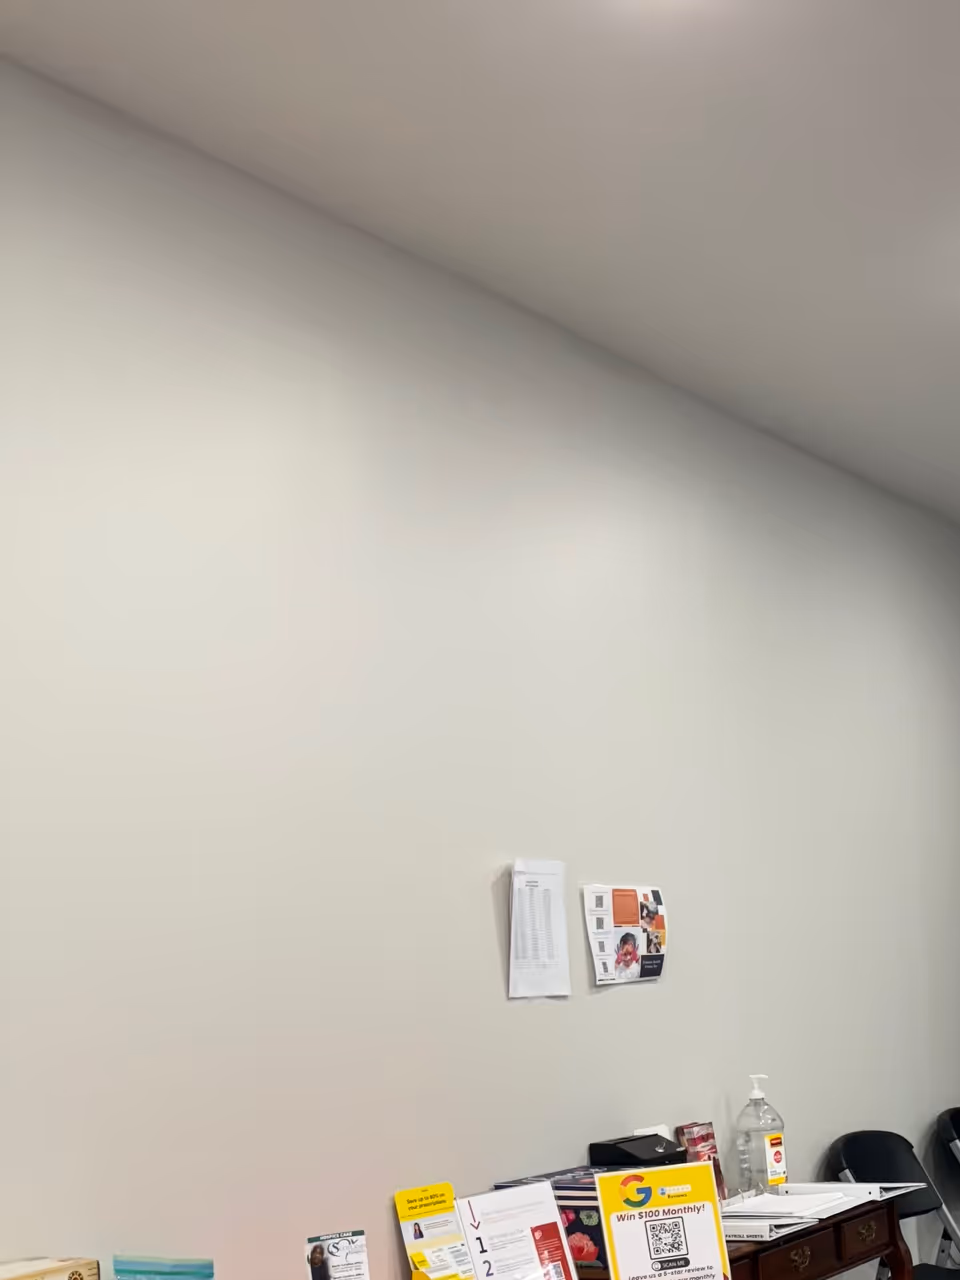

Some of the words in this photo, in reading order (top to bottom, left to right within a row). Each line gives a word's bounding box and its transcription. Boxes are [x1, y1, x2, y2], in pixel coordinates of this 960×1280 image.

[616, 1213, 636, 1222] Win
[637, 1209, 660, 1219] $100
[662, 1203, 705, 1216] Monthly!
[475, 1236, 488, 1254] 1
[482, 1259, 494, 1277] 2
[663, 1269, 684, 1277] 5-star
[684, 1266, 706, 1274] review
